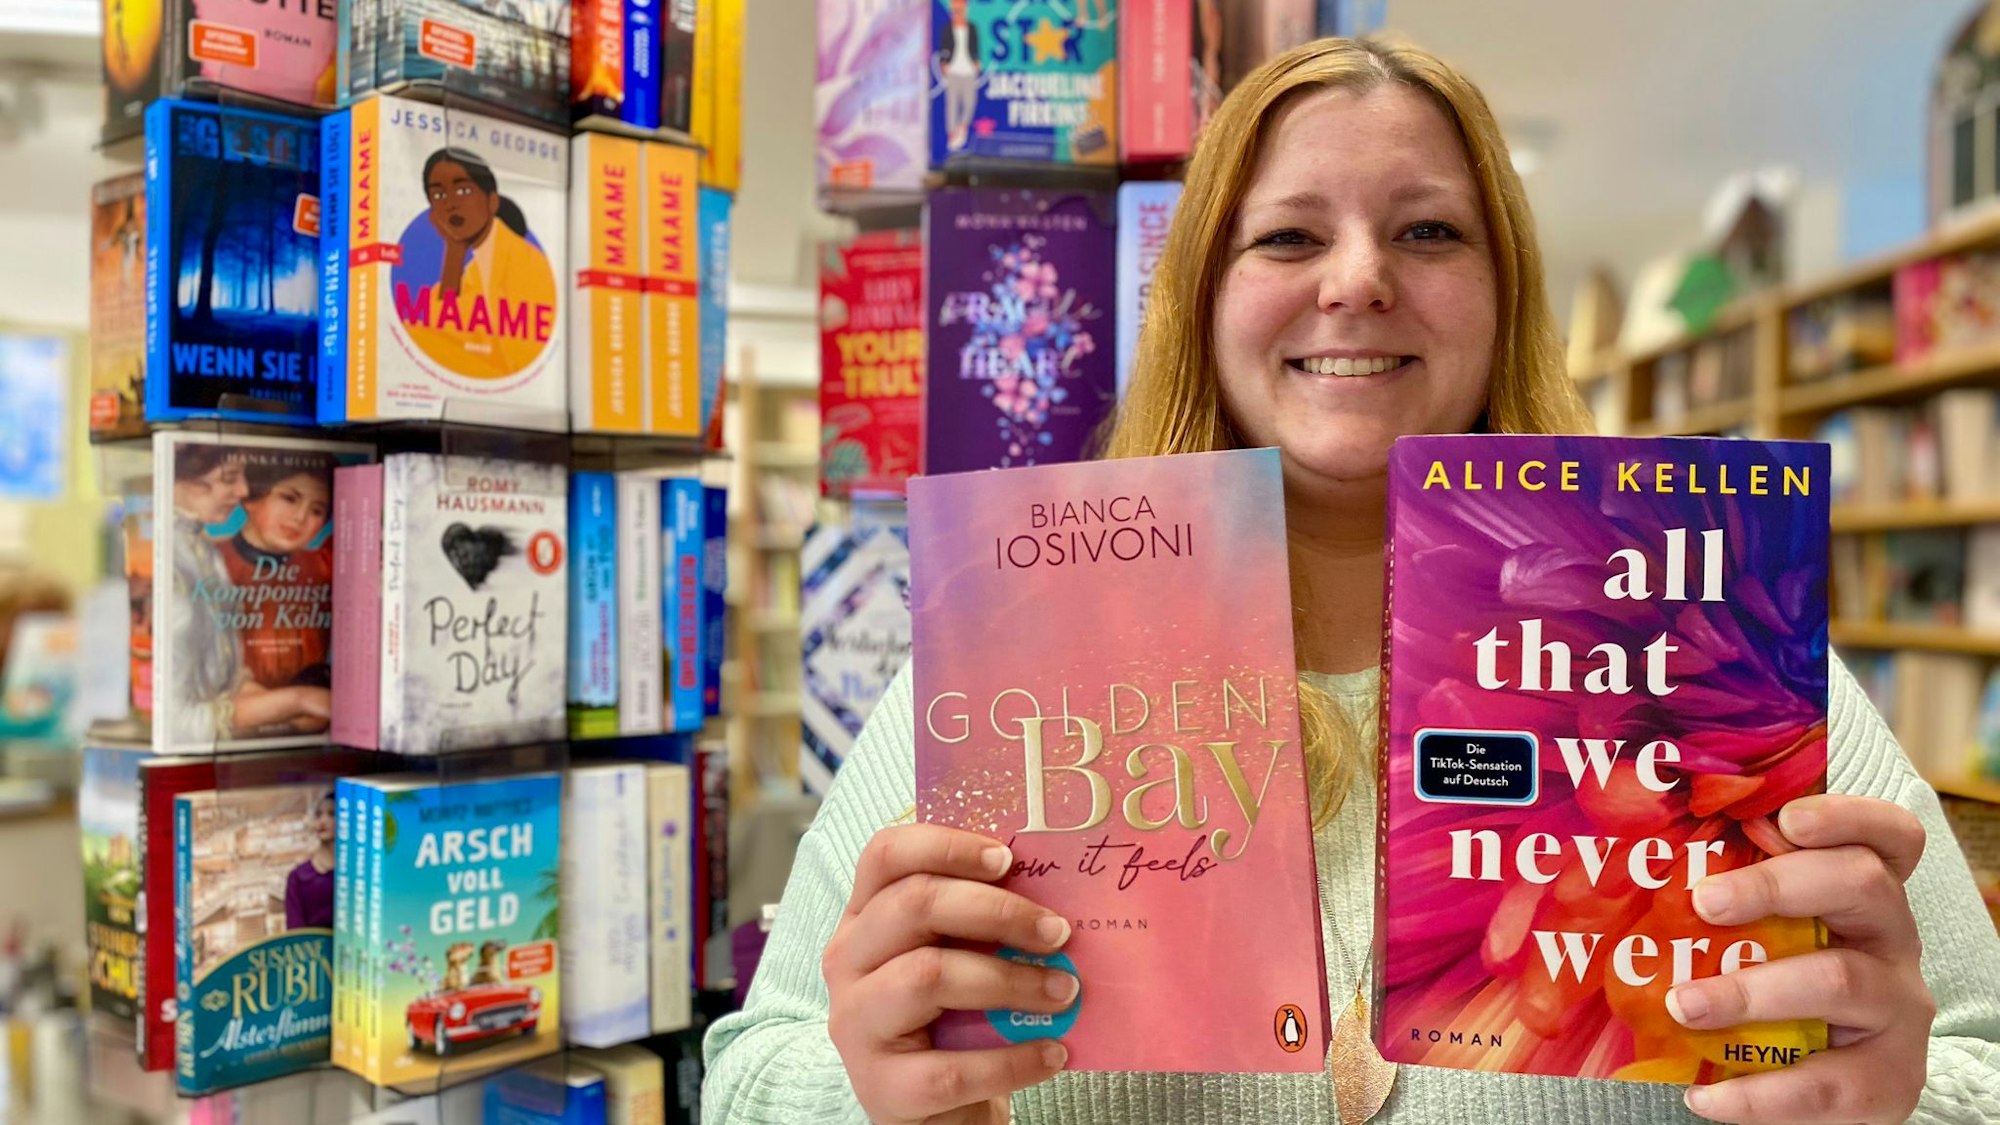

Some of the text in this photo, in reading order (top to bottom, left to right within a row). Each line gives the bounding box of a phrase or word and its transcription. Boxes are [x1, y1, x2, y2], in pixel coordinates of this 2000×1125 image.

[264, 28, 311, 48] ROMAN
[391, 110, 560, 162] JESSICA GEORGE
[358, 128, 371, 240] MAAME
[605, 164, 626, 266] MAAME
[661, 172, 683, 273] MAAME
[396, 282, 553, 343] MAAME
[173, 342, 254, 378] WENN
[261, 351, 302, 382] SIE
[467, 476, 521, 493] ROMY
[1422, 460, 1811, 496] ALICE KELLEN
[437, 494, 545, 514] HAUSMANN
[1031, 495, 1156, 529] BIANCA
[251, 556, 300, 582] Die
[996, 523, 1193, 570] IOSIVONI
[1603, 527, 1726, 603] all
[191, 576, 331, 609] Komponist
[214, 605, 331, 630] von Köln
[424, 590, 546, 662] Perfect
[447, 650, 537, 706] Day
[1472, 618, 1680, 696] that
[926, 676, 1268, 744] GOLDEN
[1430, 757, 1522, 772] TikTok-Sensation
[1466, 743, 1486, 754] Die
[1554, 737, 1682, 792] we
[1011, 715, 1291, 861] Bay
[1443, 774, 1509, 786] auf Deutsch
[414, 822, 533, 869] ARSCH
[1079, 835, 1136, 877] it
[1118, 834, 1219, 891] feels
[1448, 829, 1725, 891] never
[446, 866, 503, 894] VOLL
[429, 892, 520, 936] GELD
[1076, 918, 1149, 931] ROMAN
[1532, 930, 1768, 997] were
[1411, 1029, 1503, 1048] ROMAN
